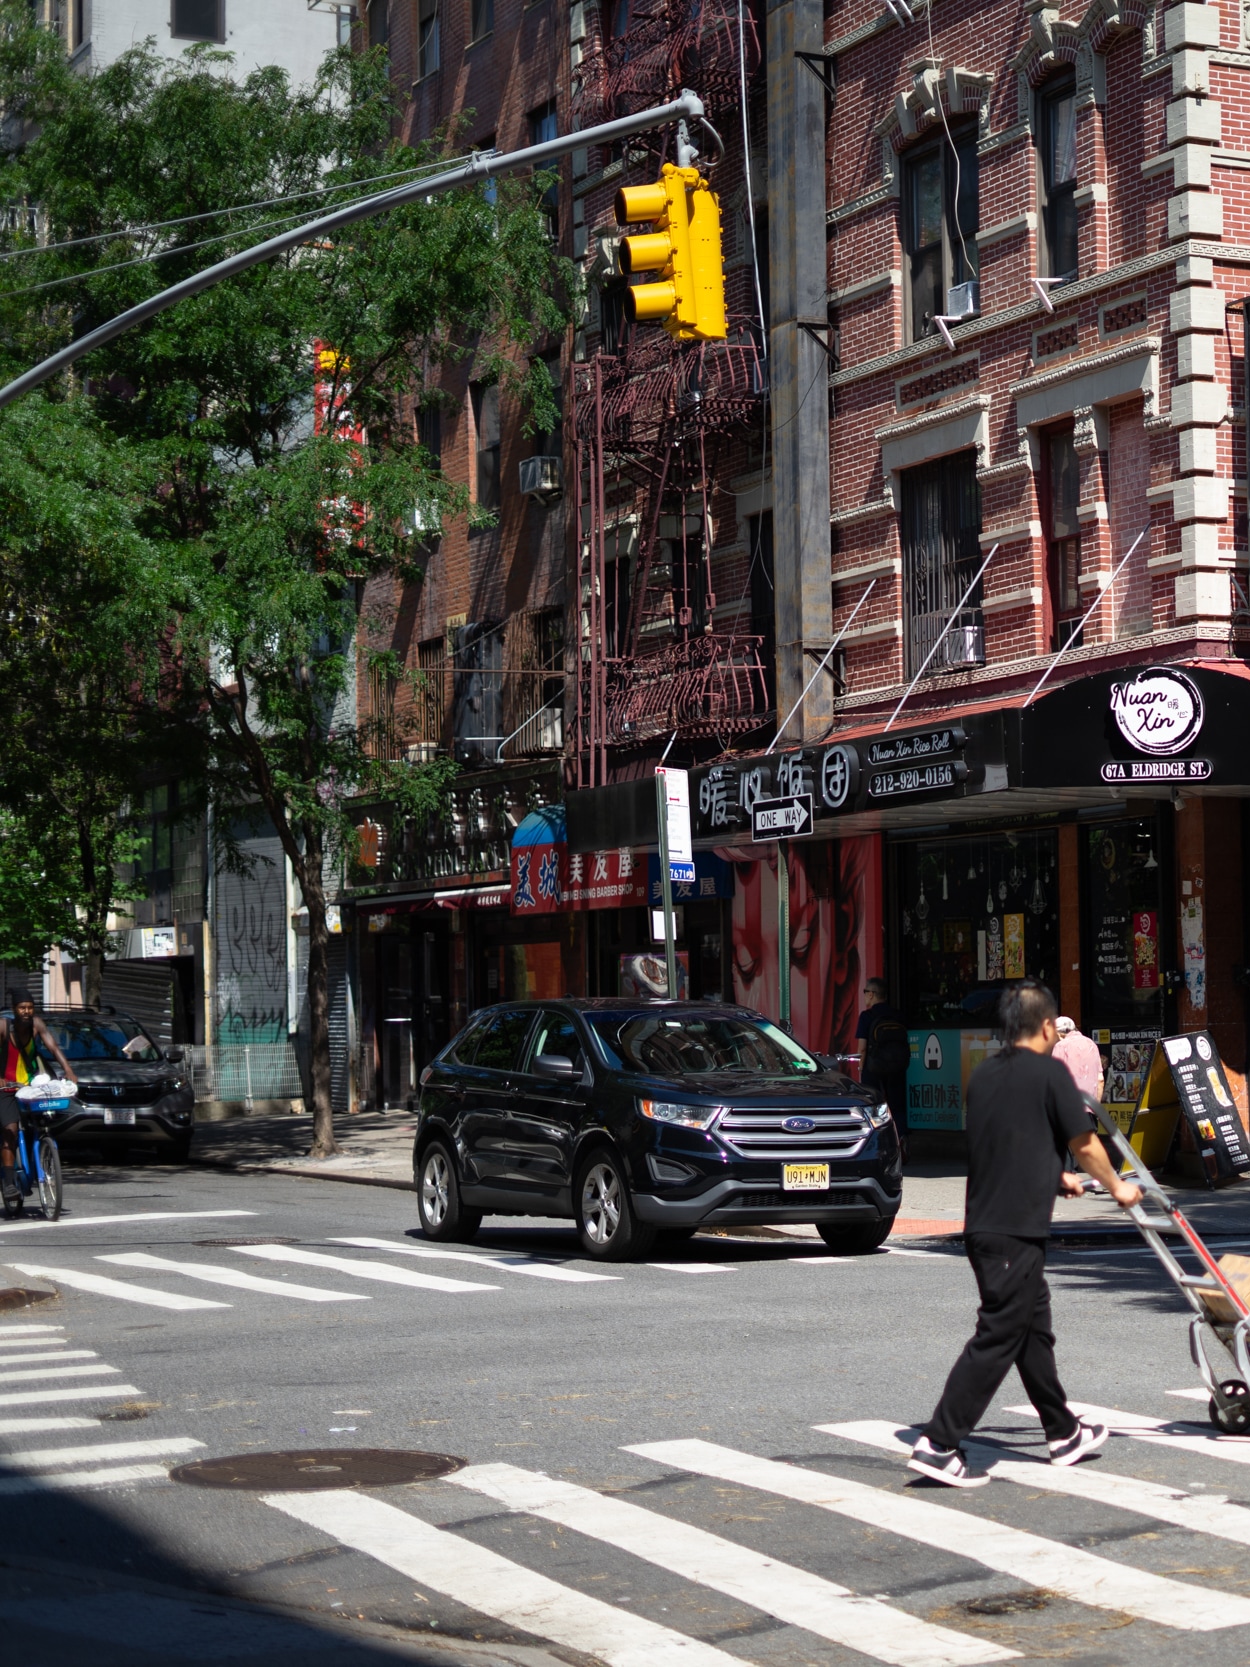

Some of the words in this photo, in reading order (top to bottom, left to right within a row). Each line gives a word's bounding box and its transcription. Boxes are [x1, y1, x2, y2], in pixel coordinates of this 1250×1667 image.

[1112, 682, 1168, 709] Nuan
[1136, 707, 1175, 733] Xin
[872, 743, 895, 762] Nuan
[896, 740, 912, 758] Xin
[912, 736, 931, 755] Rice
[931, 731, 950, 752] Roll
[874, 764, 952, 793] 212-920-0156
[1105, 764, 1126, 778] 67A
[1131, 763, 1186, 777] ELDRIDGE
[1190, 762, 1207, 776] ST.
[760, 812, 777, 828] ONE
[785, 808, 803, 825] WAY
[569, 846, 635, 885] 美发屋
[597, 884, 618, 898] BARBER
[618, 882, 634, 895] SHOP
[909, 1084, 960, 1109] 饭团外卖
